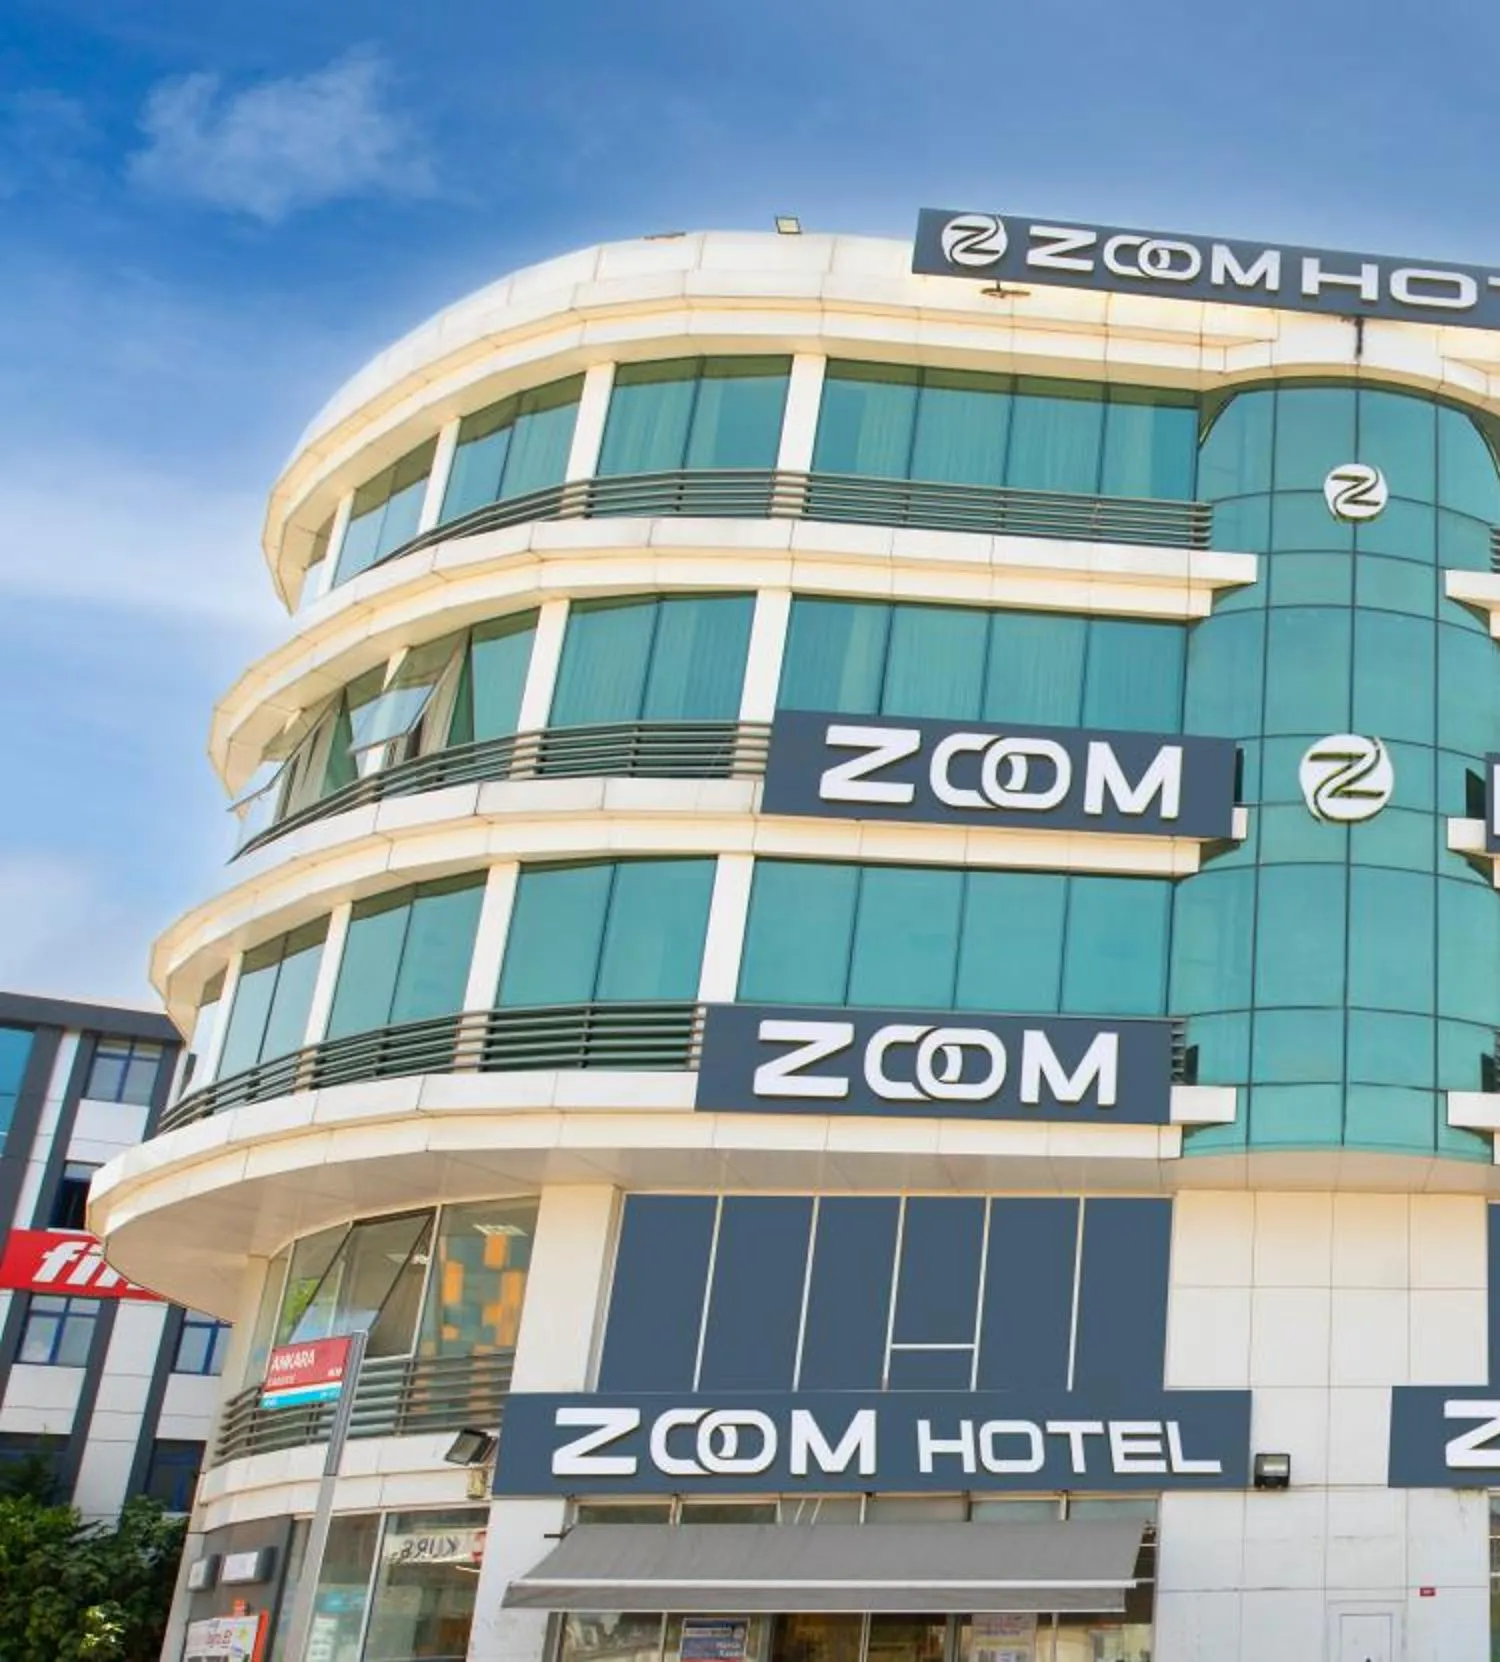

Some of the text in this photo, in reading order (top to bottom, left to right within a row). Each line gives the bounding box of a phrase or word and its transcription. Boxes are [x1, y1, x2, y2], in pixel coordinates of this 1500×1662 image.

[1026, 224, 1281, 292] ZOOM
[818, 724, 1182, 818] ZOOM
[753, 1018, 1118, 1106] ZOOM
[550, 1406, 1222, 1476] ZOOM HOTEL
